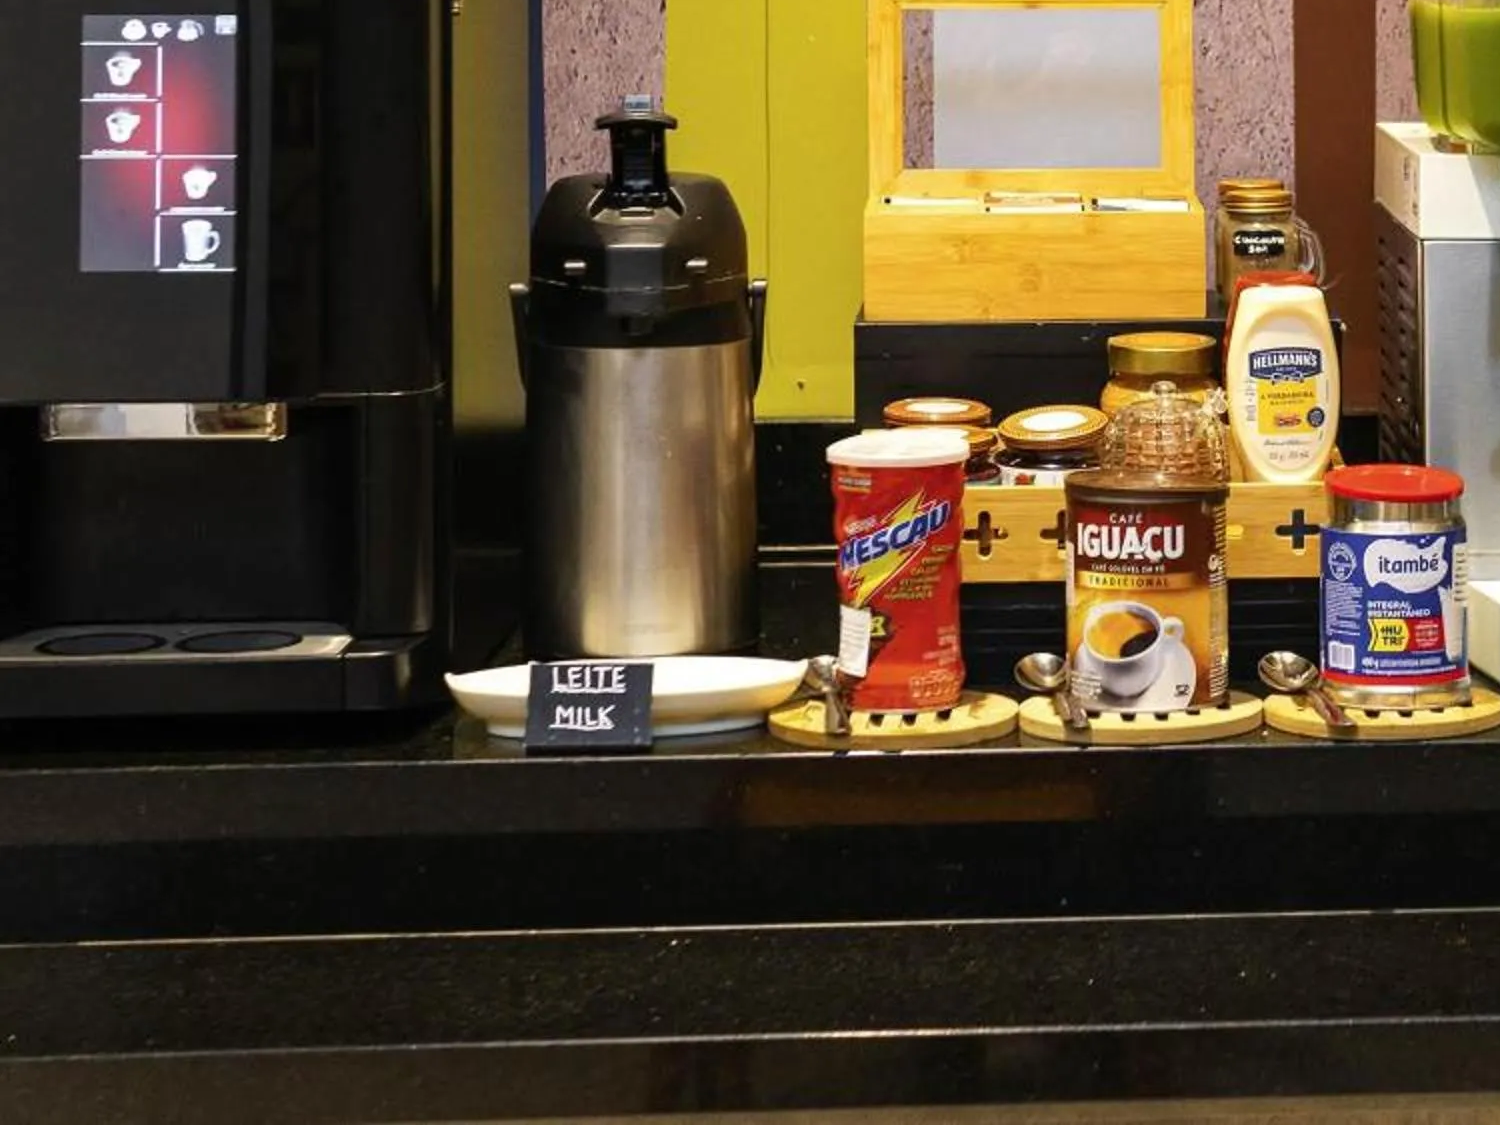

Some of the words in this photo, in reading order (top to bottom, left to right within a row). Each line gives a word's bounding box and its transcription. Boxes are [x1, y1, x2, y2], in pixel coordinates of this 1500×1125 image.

[1253, 351, 1317, 370] HELLMANN'S
[1109, 512, 1144, 524] CAFÉ
[841, 500, 950, 571] NESCAU
[1077, 522, 1185, 563] IGUAÇU
[1378, 553, 1439, 574] itambé
[1089, 575, 1169, 587] TRADICIONAL
[553, 666, 627, 690] LEITE
[554, 705, 616, 726] MILK
